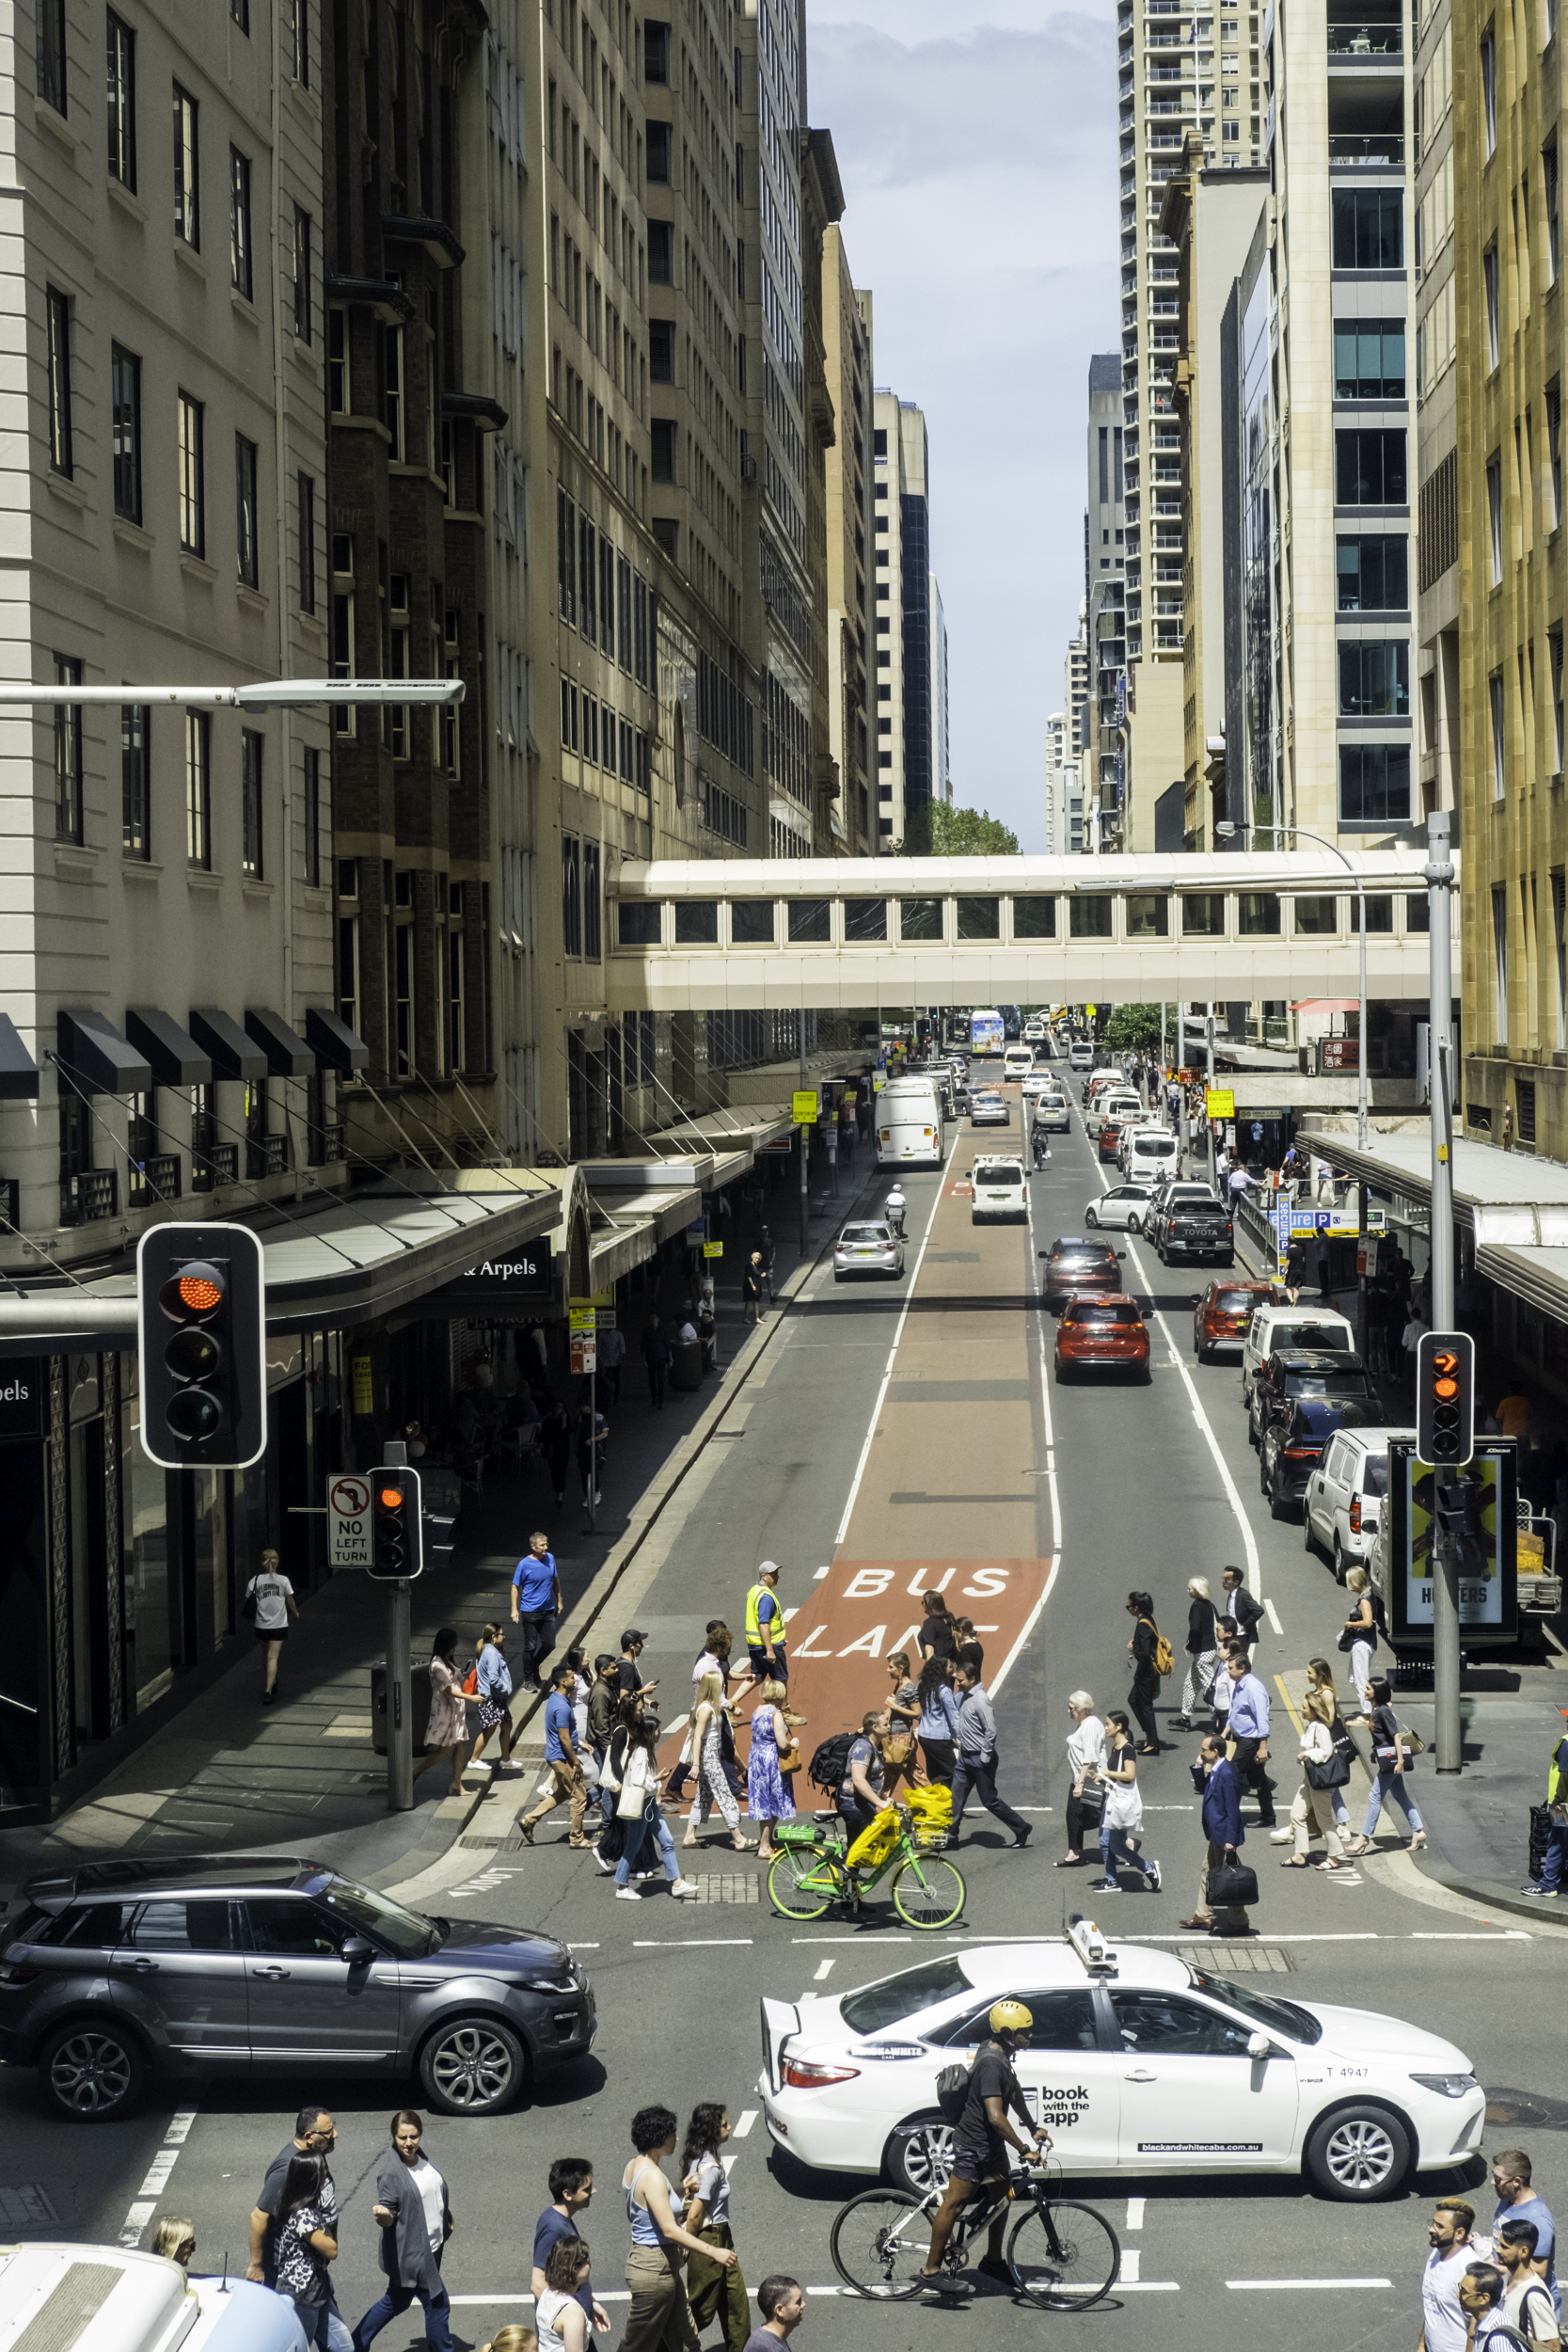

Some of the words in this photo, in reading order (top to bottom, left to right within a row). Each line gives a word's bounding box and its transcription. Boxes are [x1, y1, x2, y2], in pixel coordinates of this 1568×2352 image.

[823, 1092, 830, 1101] P
[1280, 1203, 1289, 1238] secure
[1319, 1214, 1327, 1226] P
[1281, 1241, 1289, 1249] P
[480, 1258, 537, 1281] Arpels
[339, 1520, 363, 1535] NO
[337, 1538, 367, 1549] LEFT
[335, 1551, 368, 1562] TURN
[842, 1567, 1010, 1597] BUS
[1422, 1587, 1487, 1603] HERS
[453, 1867, 525, 1892] LOOK
[1326, 2067, 1333, 2077] T
[1340, 2068, 1369, 2077] 4947
[1042, 2086, 1089, 2101] book
[1043, 2101, 1069, 2111] with
[1071, 2101, 1089, 2111] the
[1043, 2110, 1079, 2127] app
[1141, 2143, 1259, 2152] blackandwhitecabs.com.au
